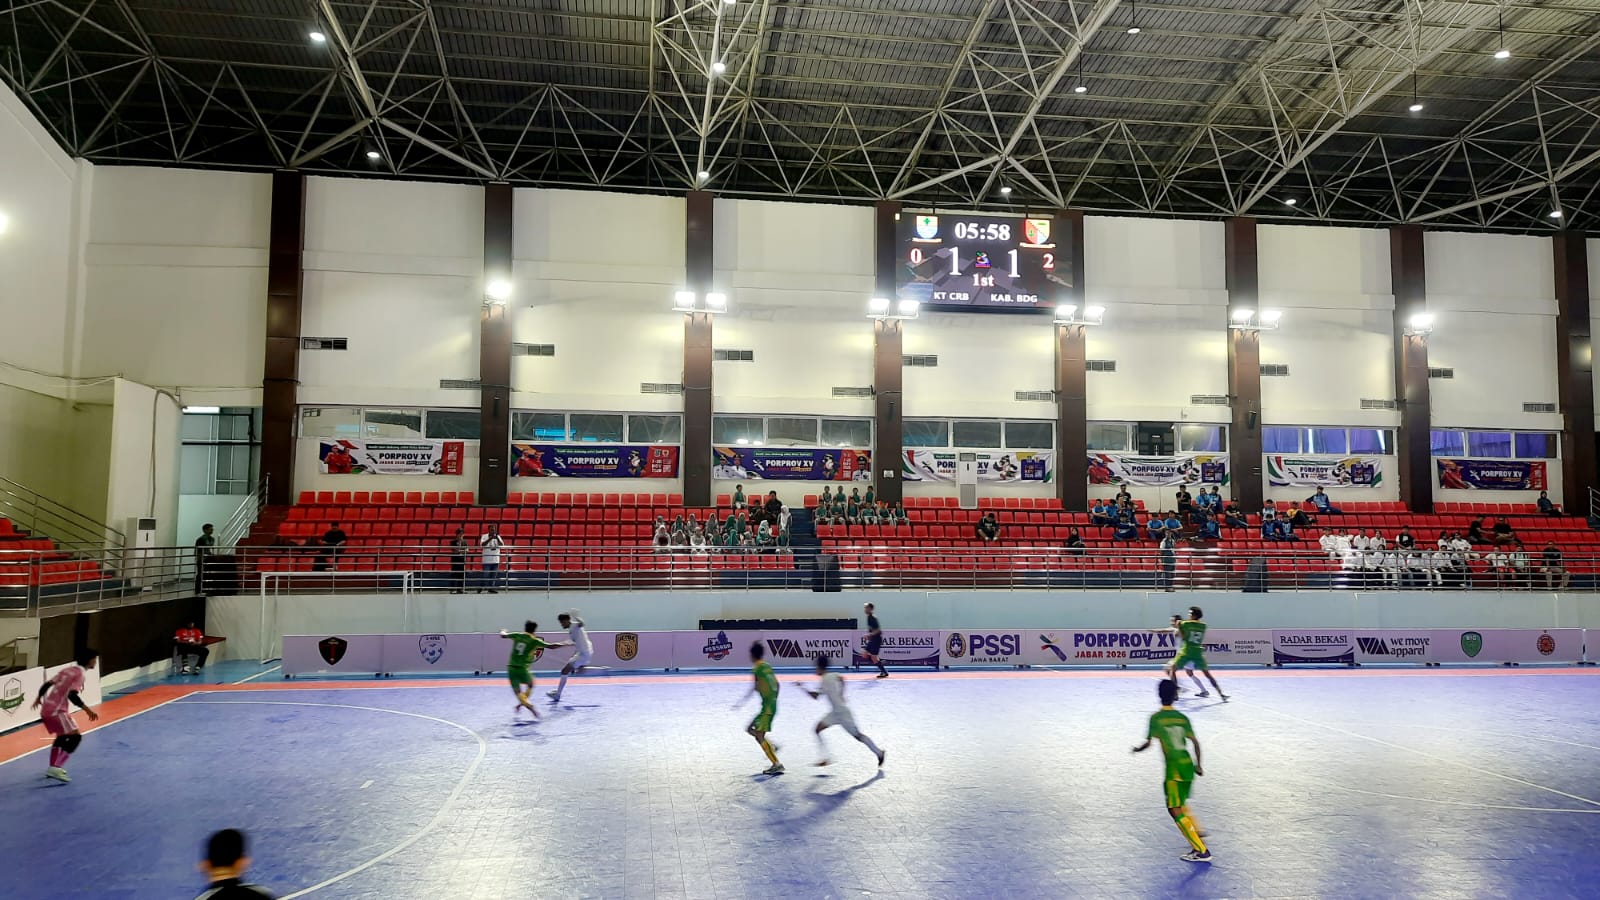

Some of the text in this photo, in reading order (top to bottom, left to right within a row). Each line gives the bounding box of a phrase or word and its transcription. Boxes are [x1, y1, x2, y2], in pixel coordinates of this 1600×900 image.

[954, 222, 1011, 241] 05:58
[911, 248, 922, 263] 0
[949, 247, 962, 276] 1
[1008, 249, 1021, 278] 1
[1043, 254, 1055, 268] 2
[973, 274, 995, 287] 1st
[934, 292, 969, 301] KT CRB
[991, 294, 1038, 303] KAB. BDG
[567, 457, 619, 465] PORPROV XV
[765, 459, 801, 467] PORPROV
[1480, 470, 1512, 478] PORPROV
[805, 640, 820, 648] we
[821, 640, 850, 648] move
[861, 637, 934, 646] RAR BEKASI
[1074, 633, 1153, 648] PORPROV
[1280, 635, 1348, 644] RADAR BEKASI
[1390, 638, 1403, 646] we
[1404, 638, 1430, 646] move
[969, 634, 1021, 656] PSSI
[804, 647, 844, 660] apparel
[1106, 650, 1127, 658] 2026
[1390, 645, 1425, 657] apparel
